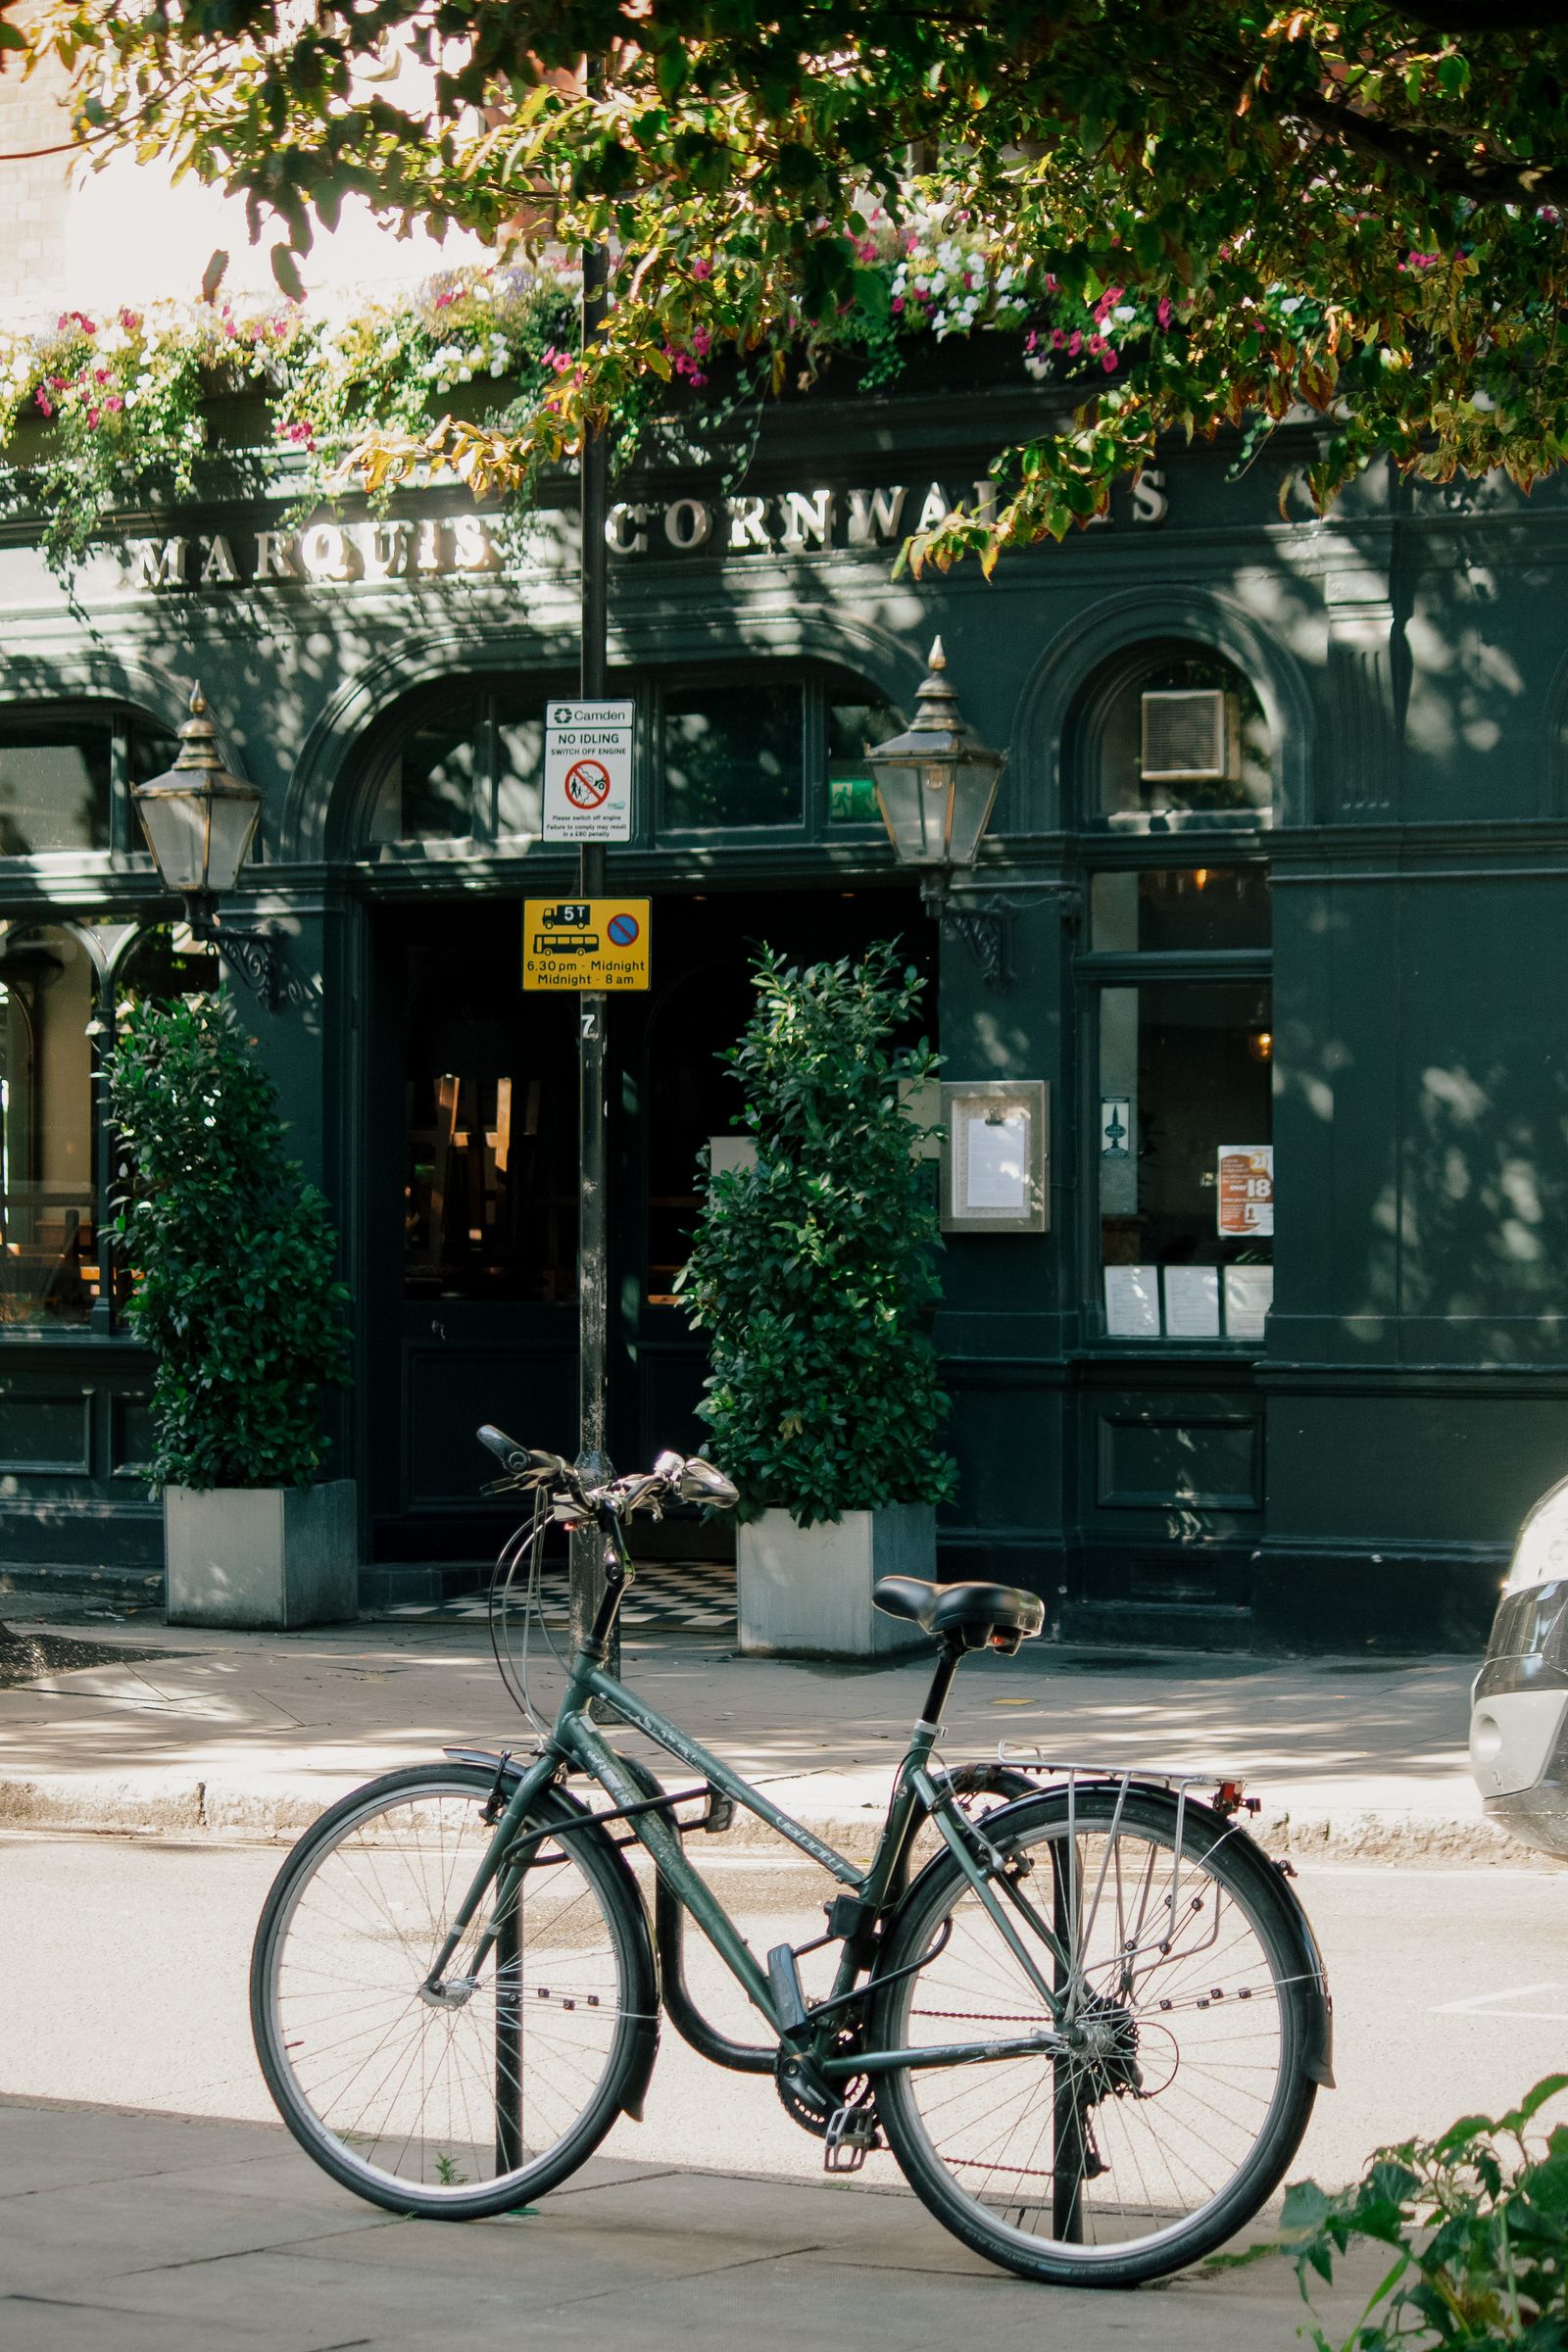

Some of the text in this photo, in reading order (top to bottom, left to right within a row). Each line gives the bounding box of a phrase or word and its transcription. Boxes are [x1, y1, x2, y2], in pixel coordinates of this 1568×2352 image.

[135, 514, 488, 588] MARQUIS
[574, 710, 625, 721] Camden
[559, 733, 619, 744] NO IDLING
[591, 960, 644, 972] Midnight
[538, 974, 590, 986] Midnight
[581, 1014, 595, 1038] 7
[1248, 1178, 1271, 1197] 18
